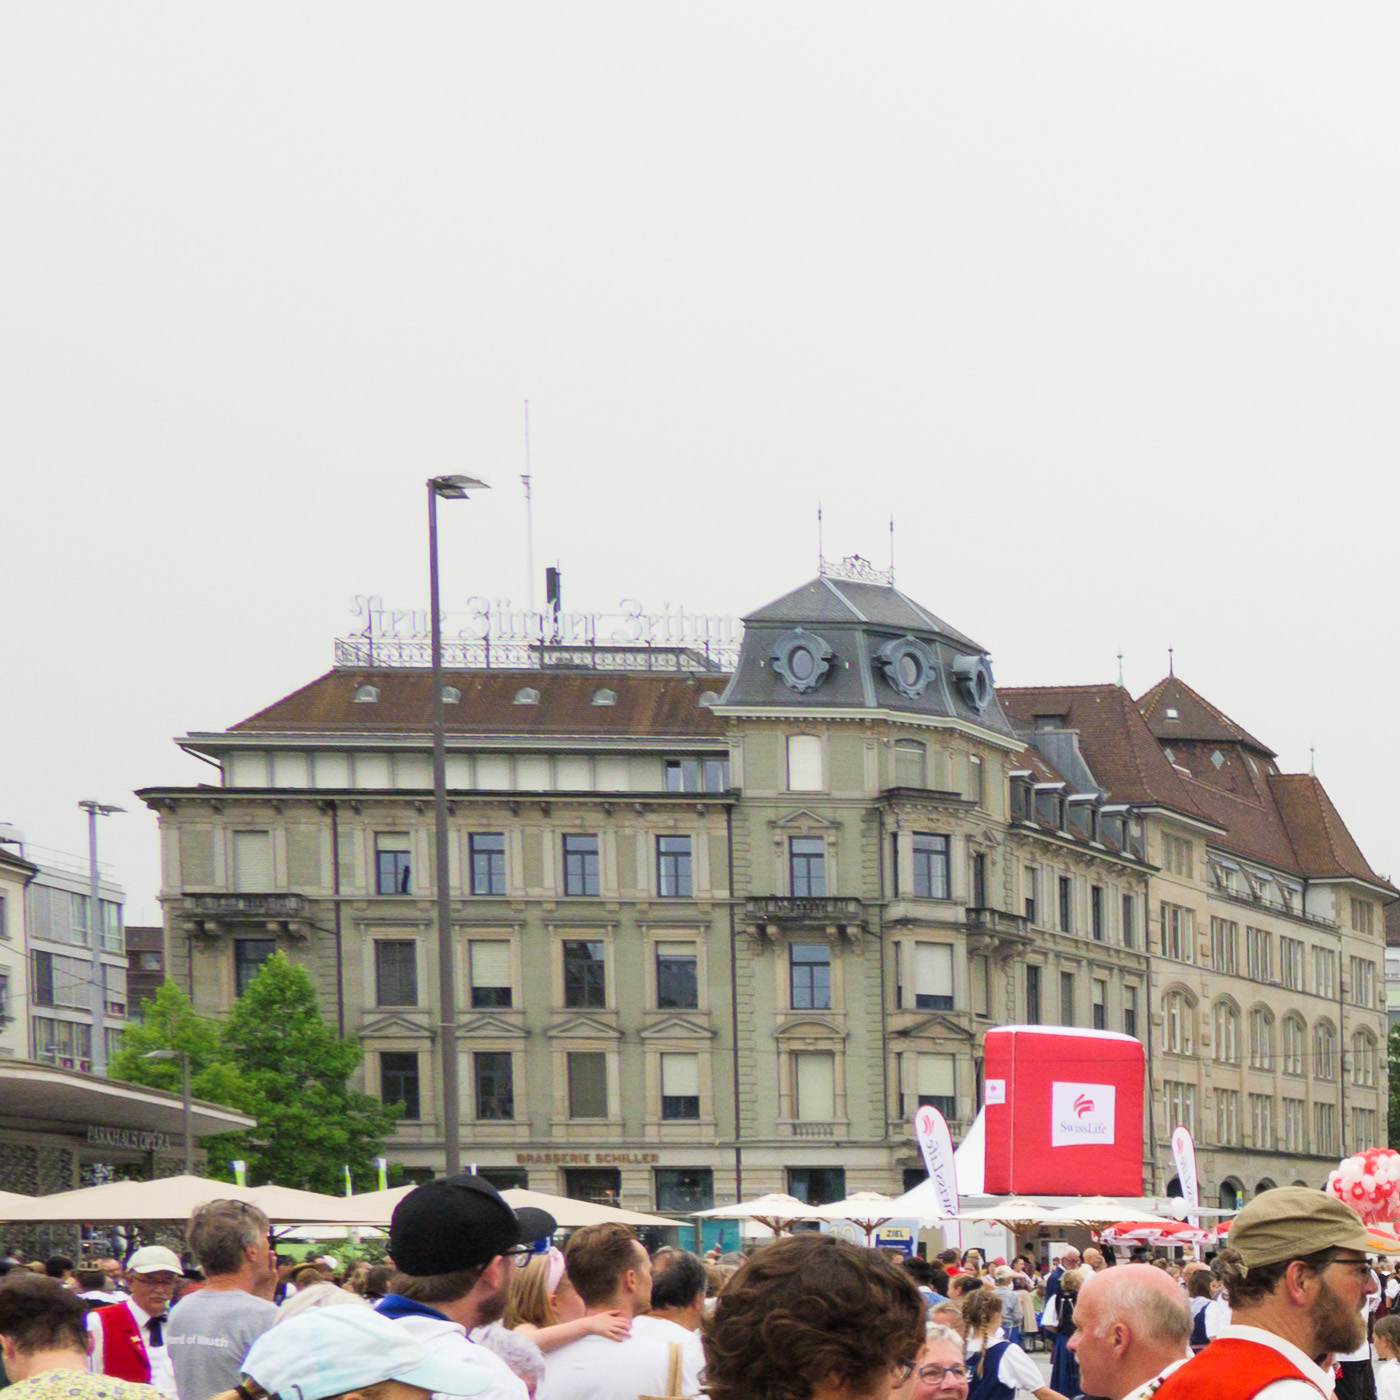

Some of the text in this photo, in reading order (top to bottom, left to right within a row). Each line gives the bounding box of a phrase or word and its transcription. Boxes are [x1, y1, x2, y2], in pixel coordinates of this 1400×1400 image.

[610, 597, 743, 643] Zeitun
[1060, 1121, 1107, 1135] SwissLife
[516, 1153, 659, 1164] BRASSERIE SCHILLER
[885, 1229, 905, 1238] ZIEL
